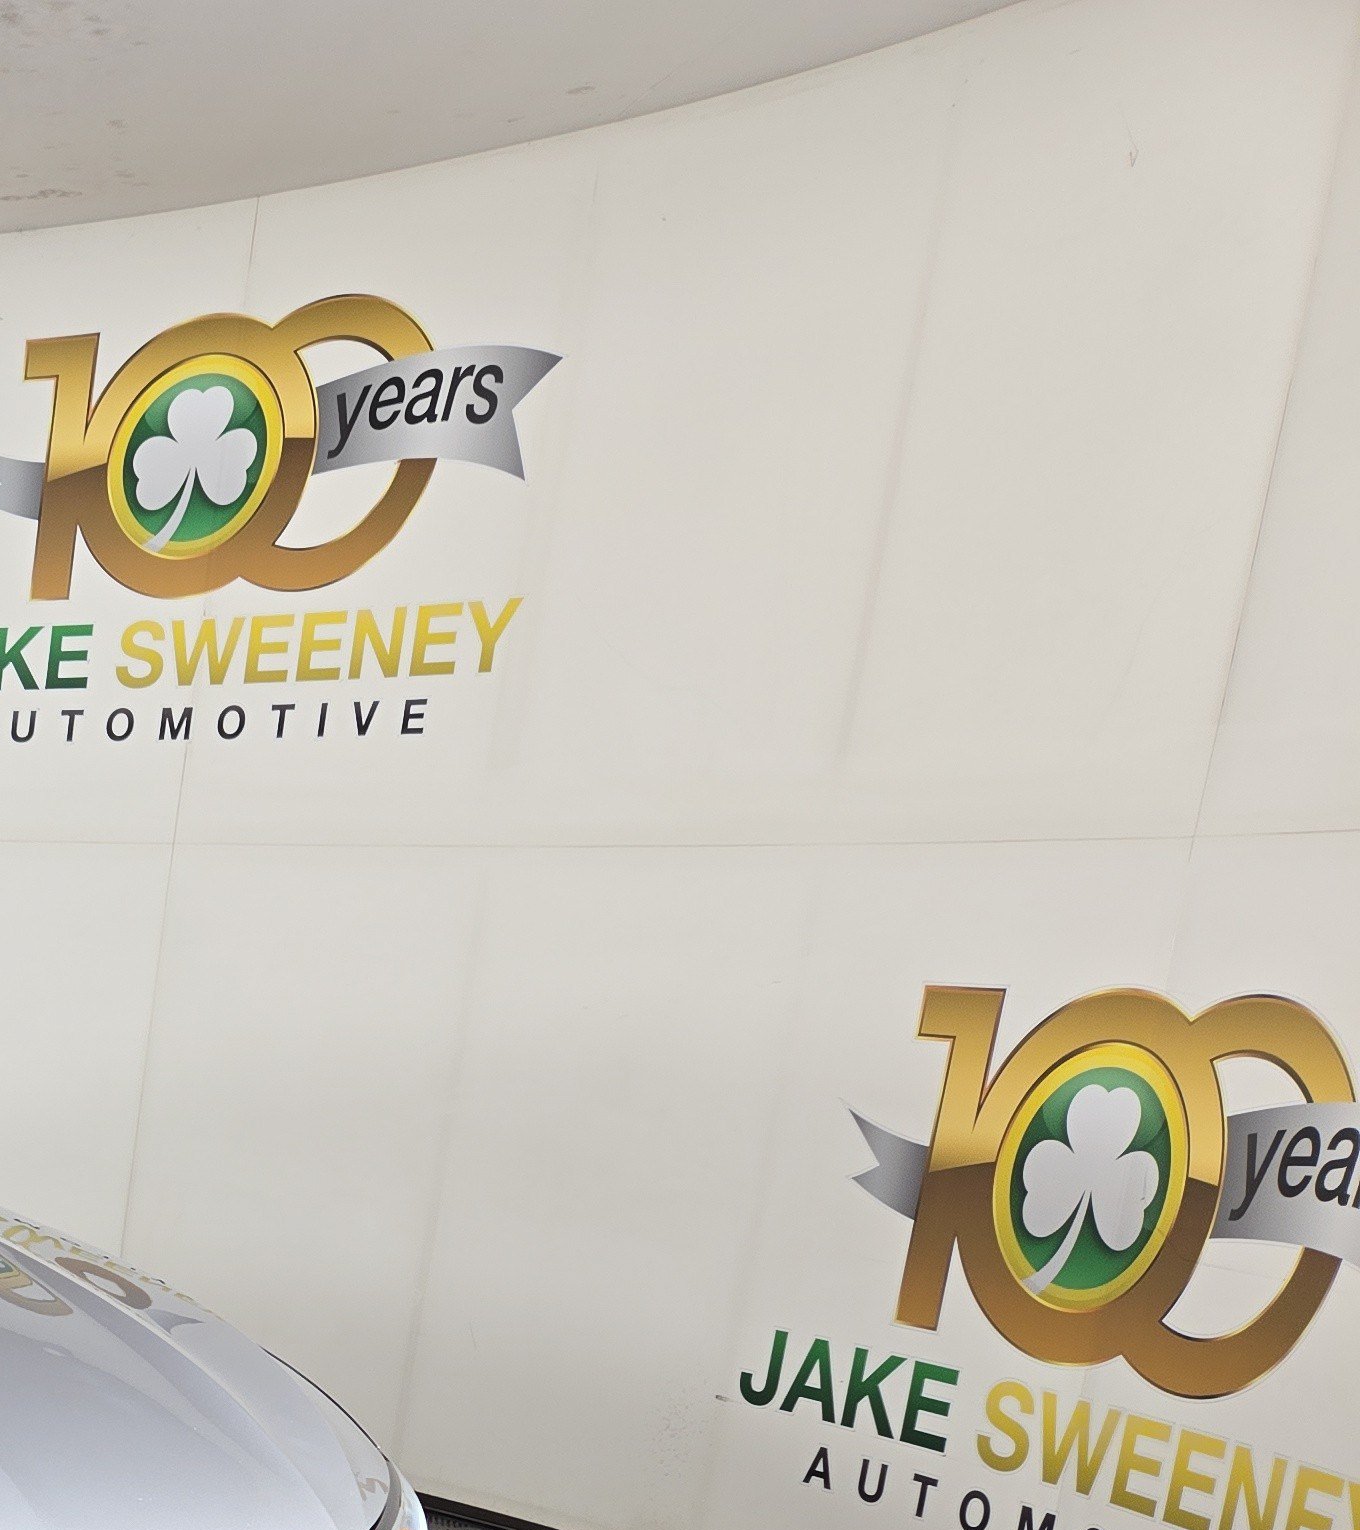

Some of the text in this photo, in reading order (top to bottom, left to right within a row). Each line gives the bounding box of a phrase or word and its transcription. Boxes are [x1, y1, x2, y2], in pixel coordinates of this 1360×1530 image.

[23, 294, 439, 600] 100
[327, 364, 504, 458] years
[116, 597, 525, 689] SWEENEY
[893, 984, 1358, 1400] 100
[1228, 1125, 1360, 1222] yea
[739, 1330, 960, 1454] JAKE
